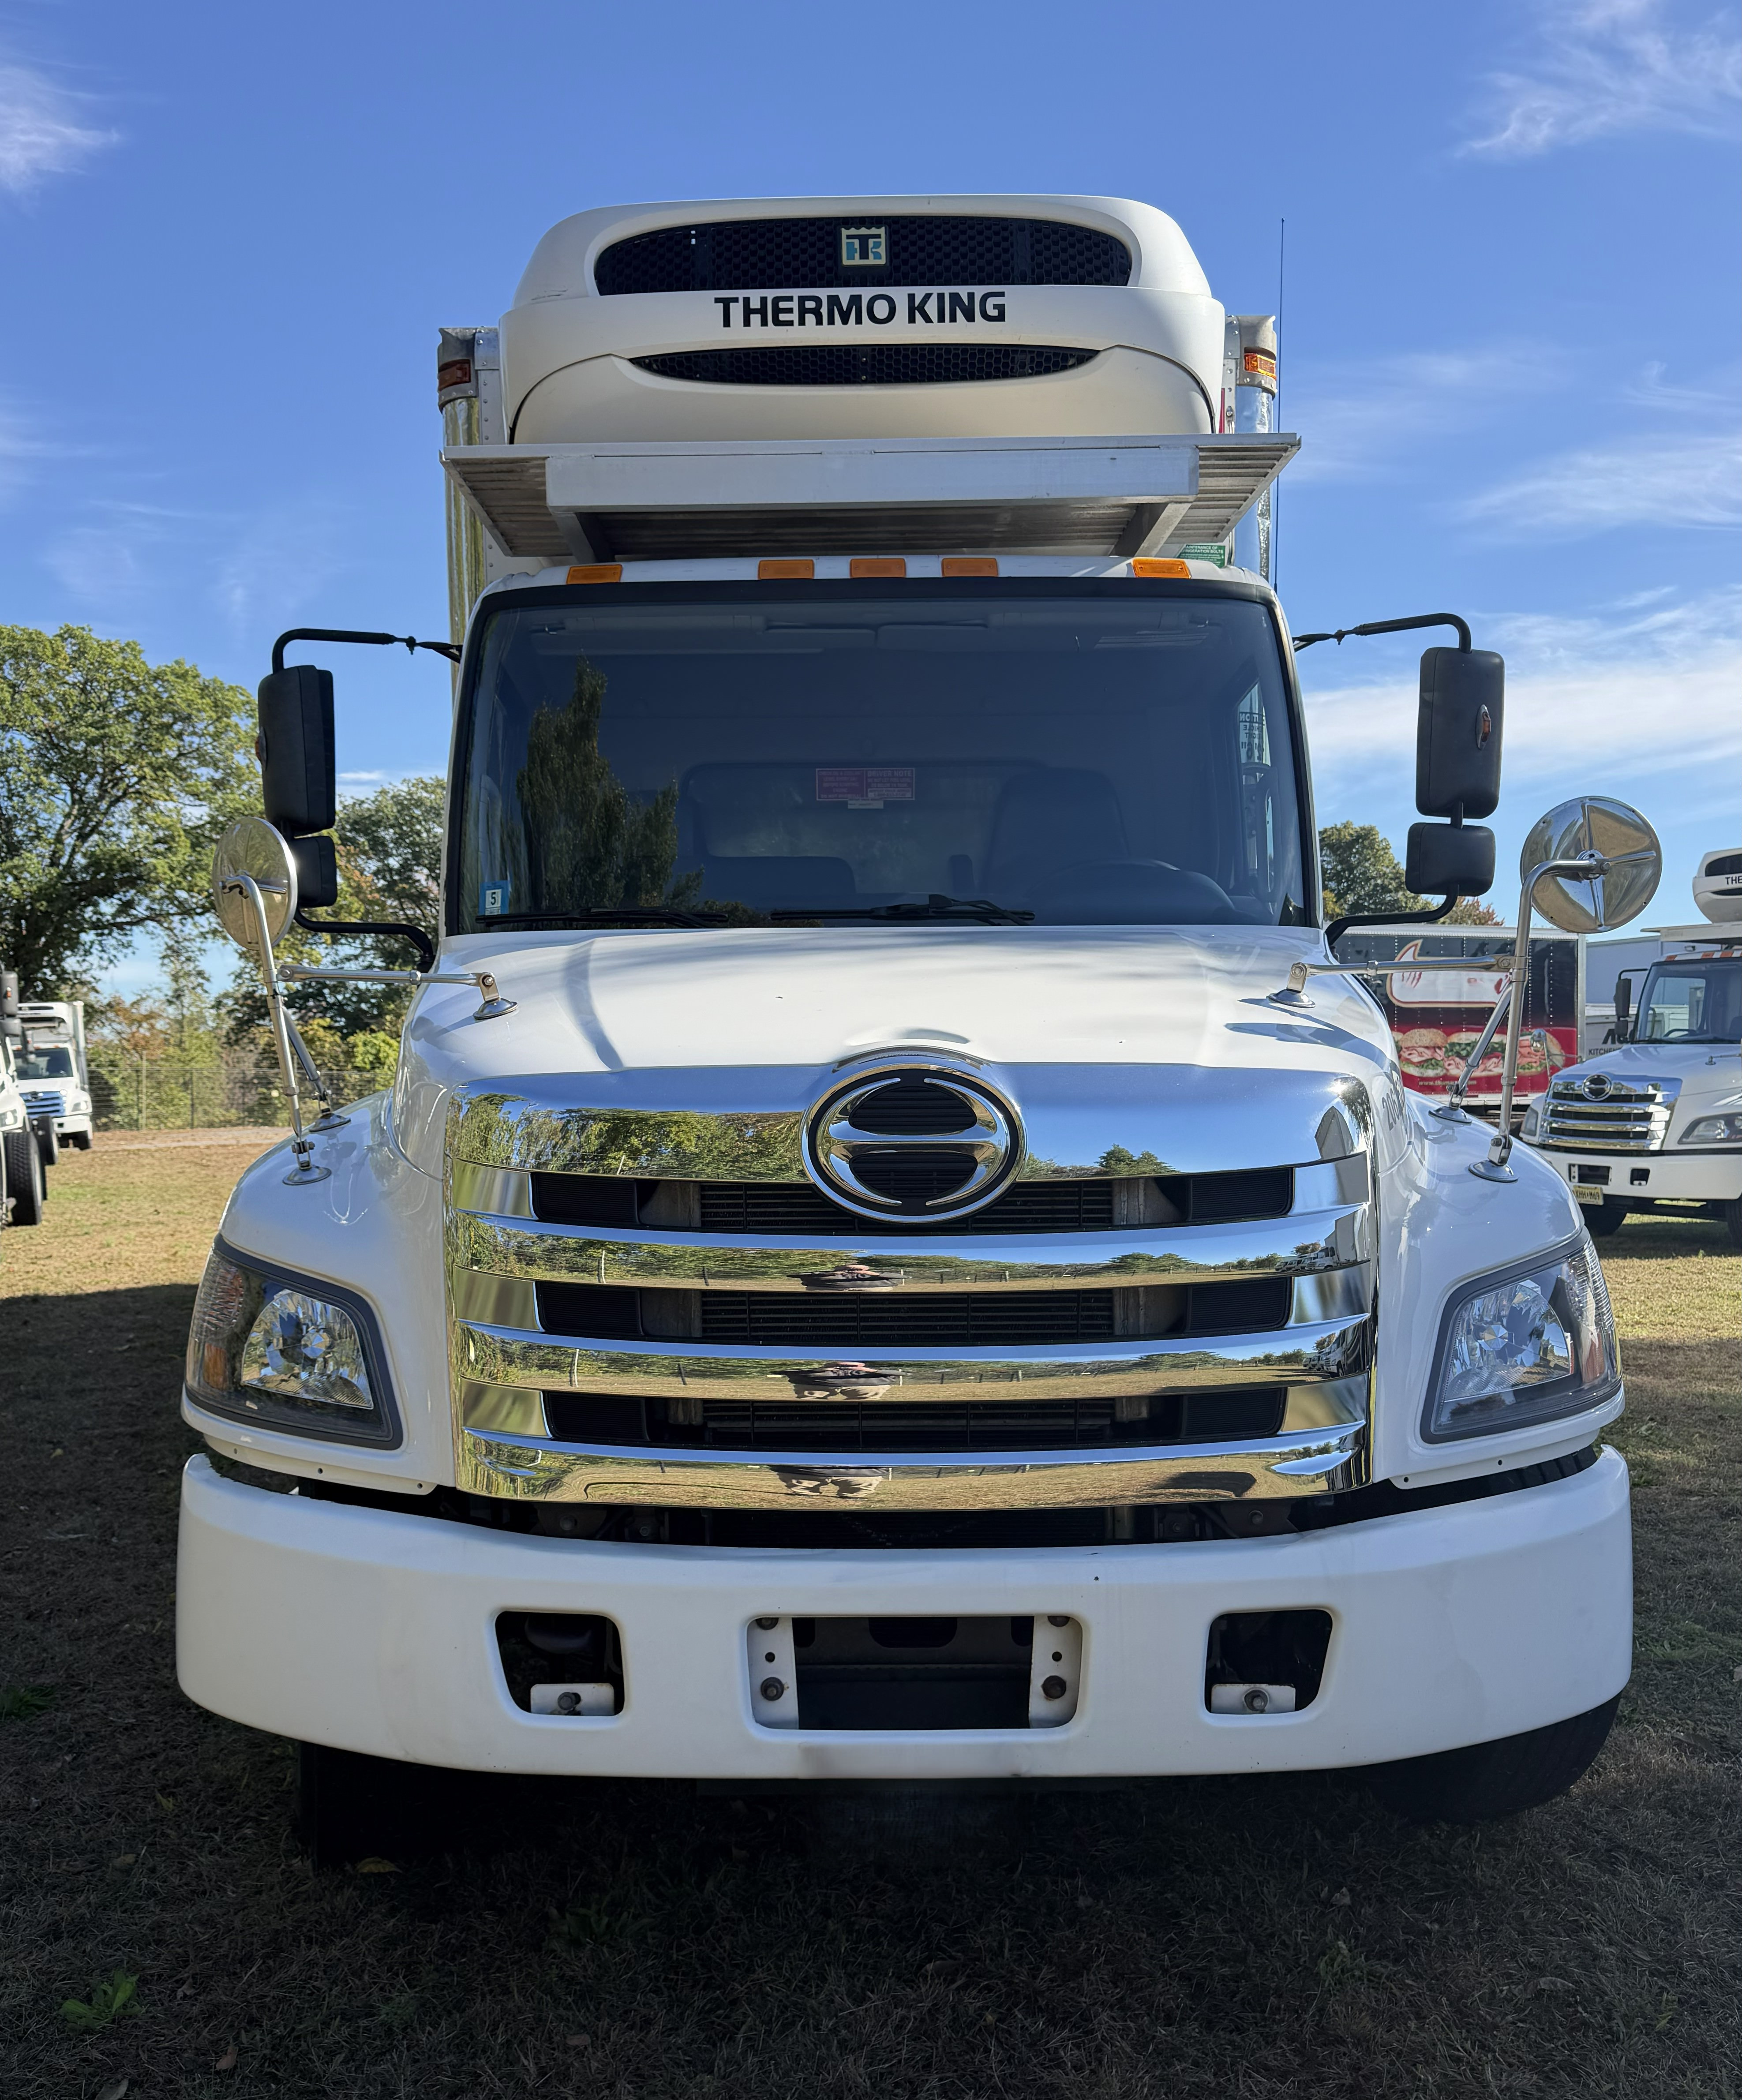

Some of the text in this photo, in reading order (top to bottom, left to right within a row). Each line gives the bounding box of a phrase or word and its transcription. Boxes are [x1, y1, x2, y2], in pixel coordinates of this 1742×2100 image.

[714, 291, 1006, 328] THERMO KING
[491, 891, 496, 906] 5
